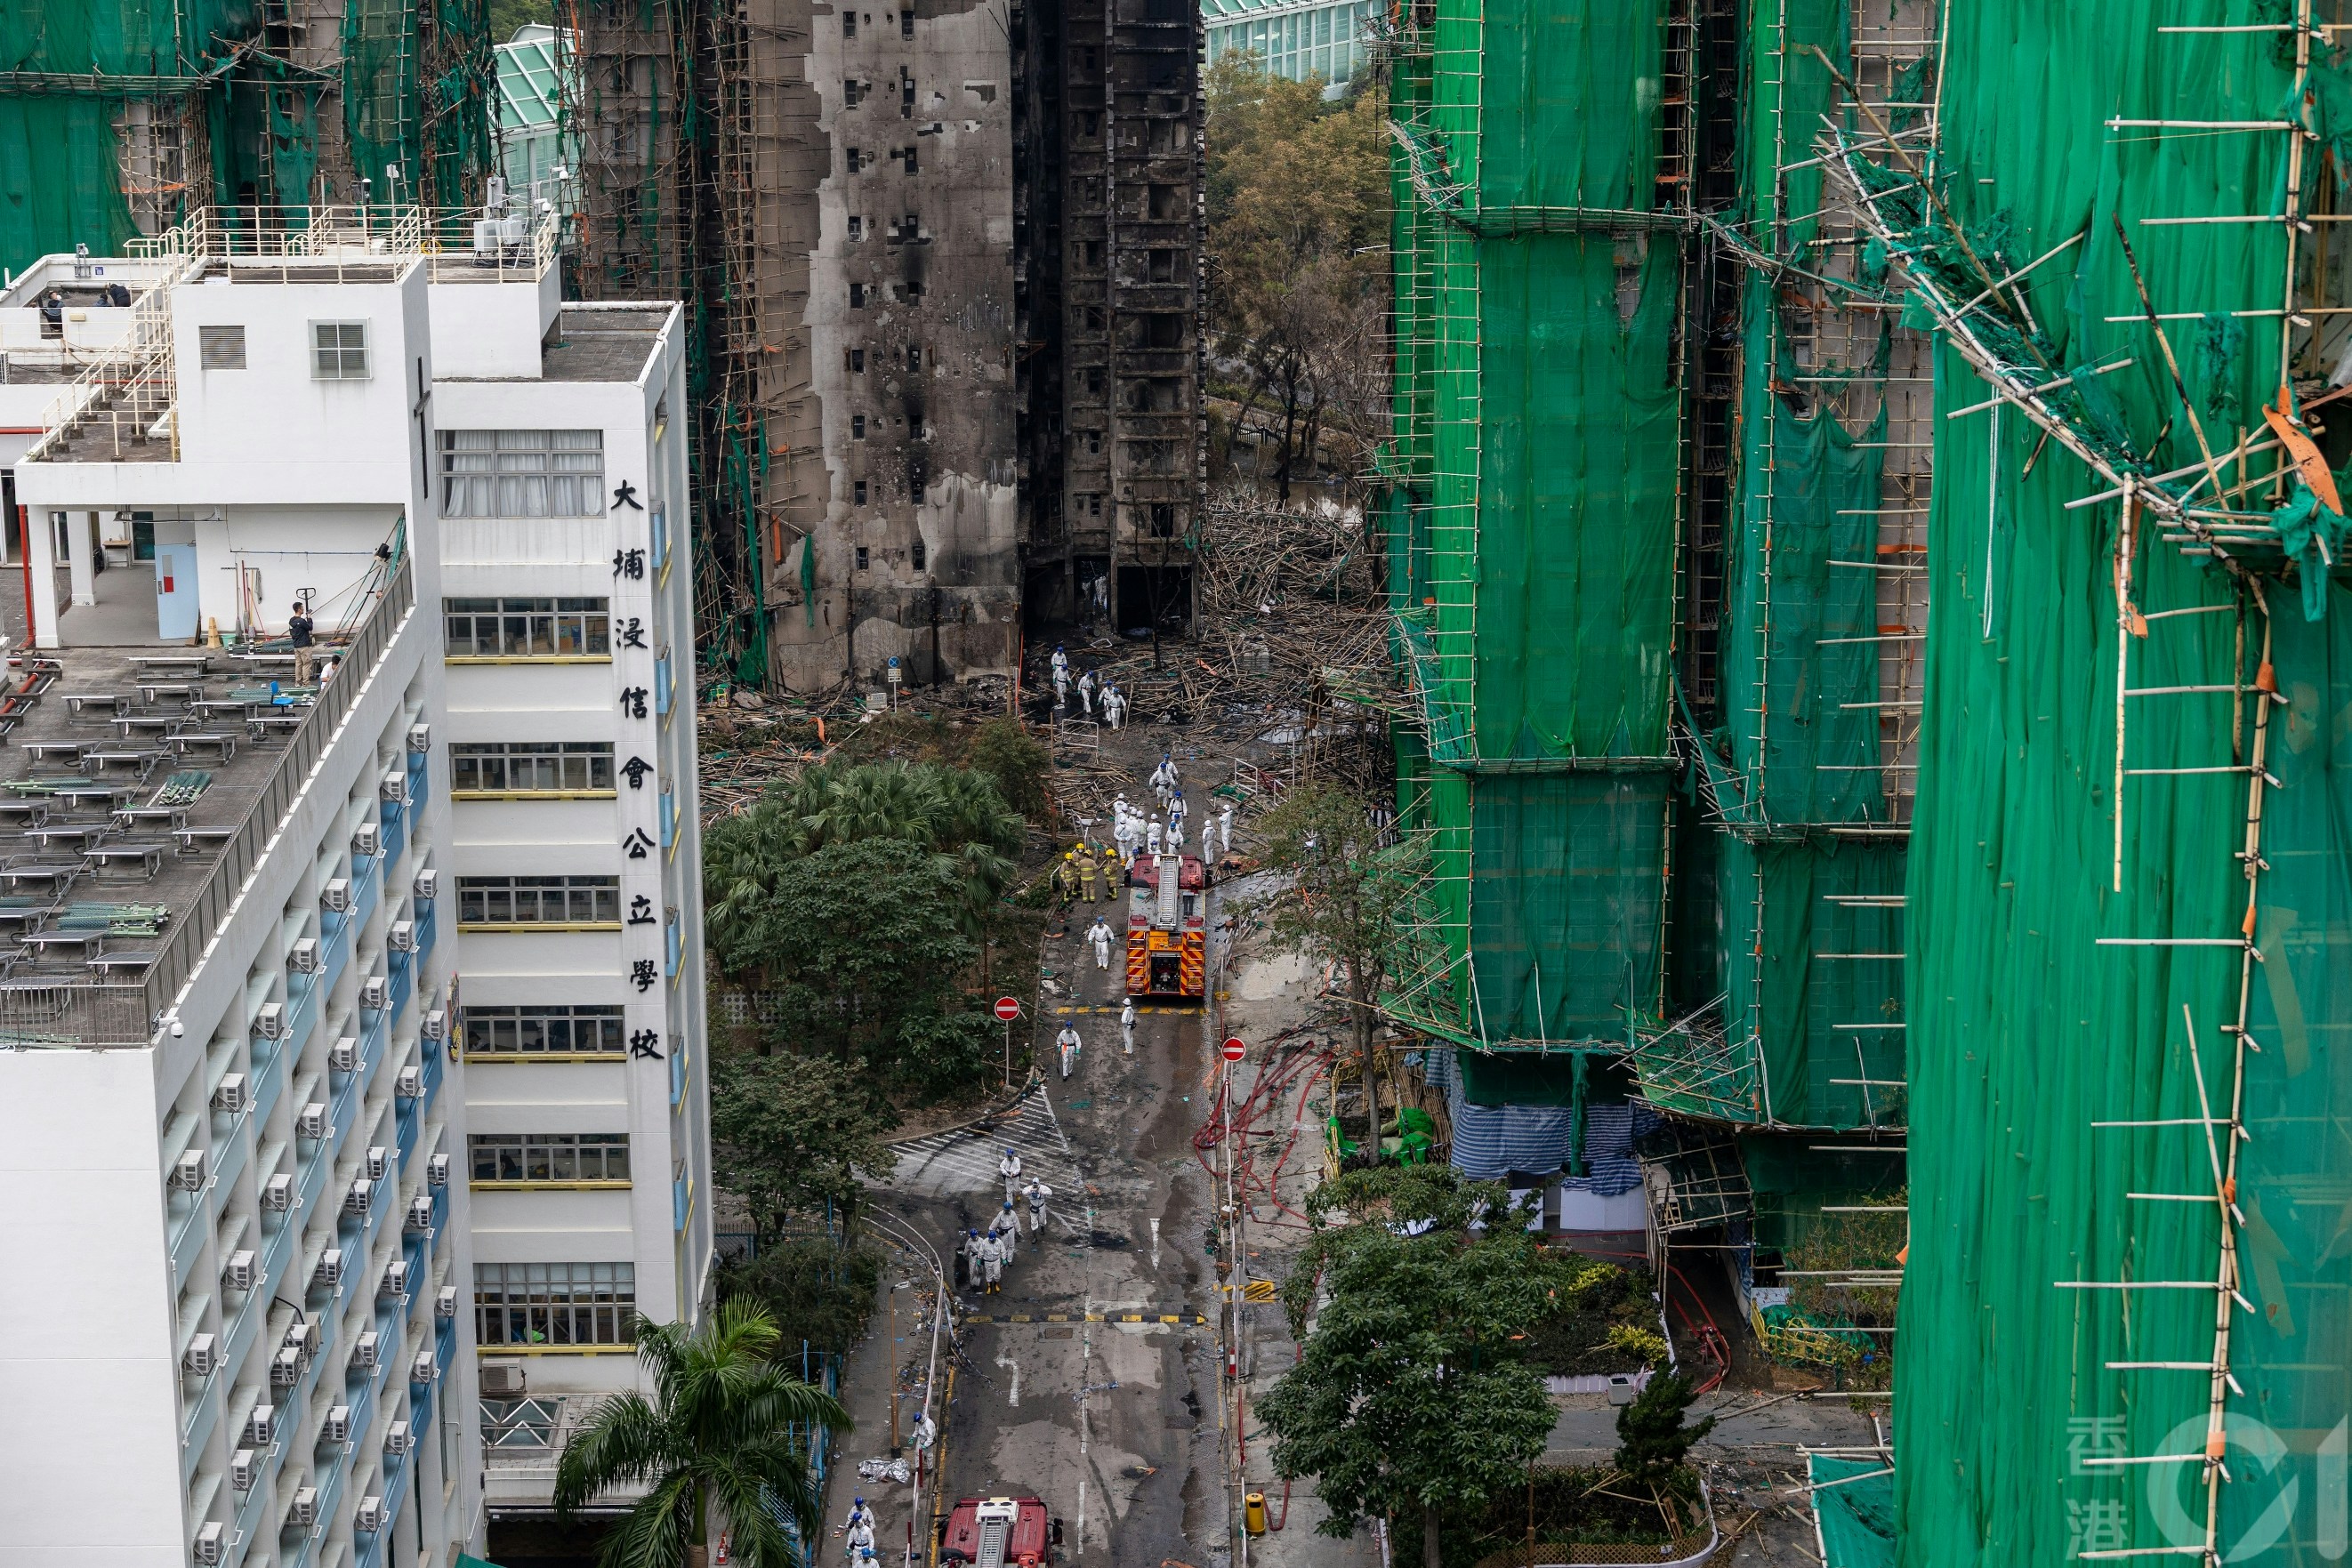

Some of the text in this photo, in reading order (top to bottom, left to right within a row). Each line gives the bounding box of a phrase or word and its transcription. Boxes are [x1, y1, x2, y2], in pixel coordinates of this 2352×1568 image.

[611, 479, 664, 1060] 大埔浸信會公立學校
